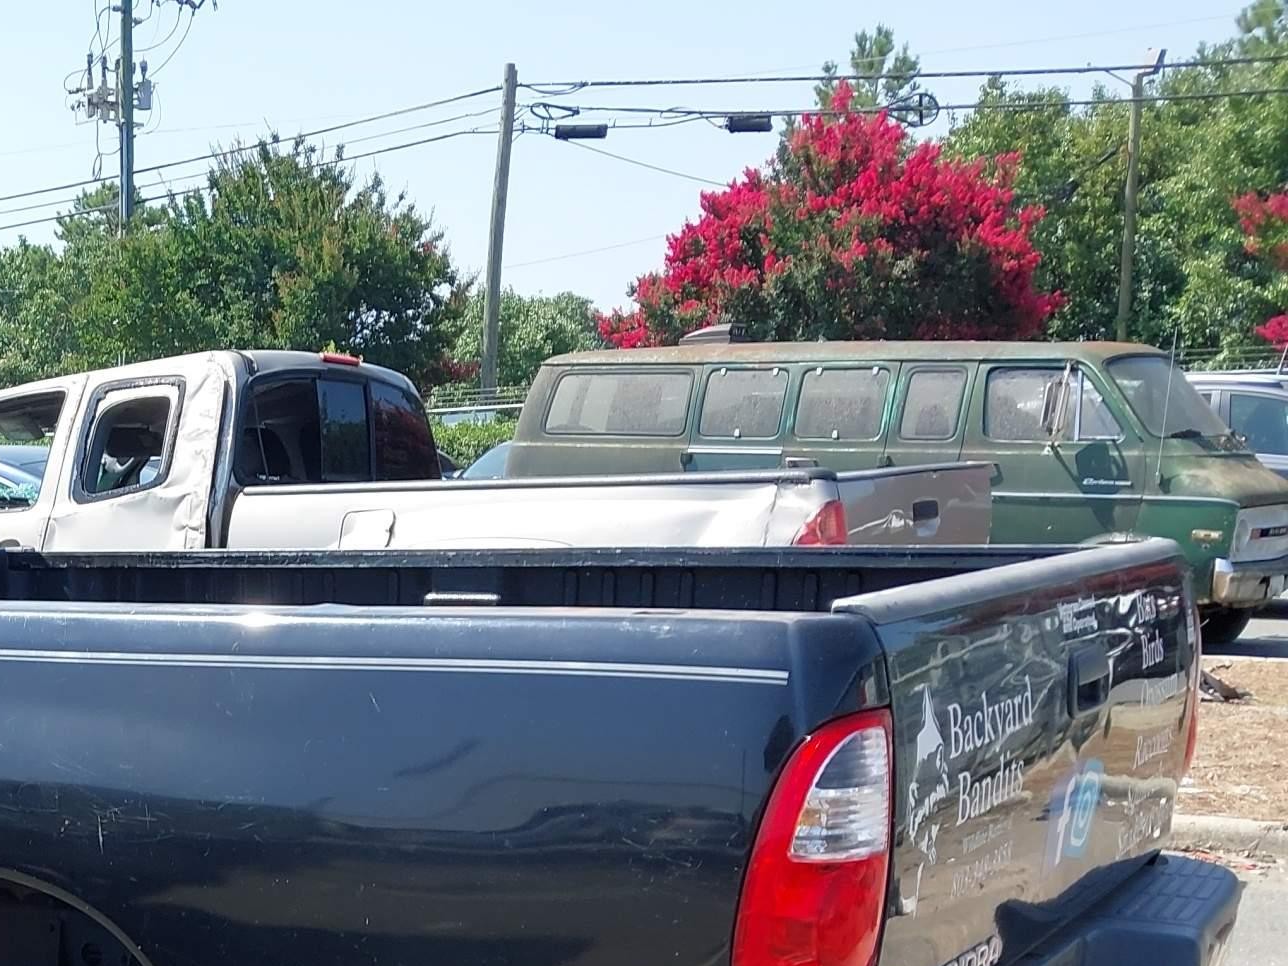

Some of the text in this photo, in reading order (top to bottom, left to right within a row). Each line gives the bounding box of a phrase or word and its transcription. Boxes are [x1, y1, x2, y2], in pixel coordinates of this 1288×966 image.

[1136, 592, 1157, 624] Bats
[1140, 629, 1165, 670] Birds
[947, 674, 1034, 759] Backyard
[956, 750, 1025, 826] Bandits
